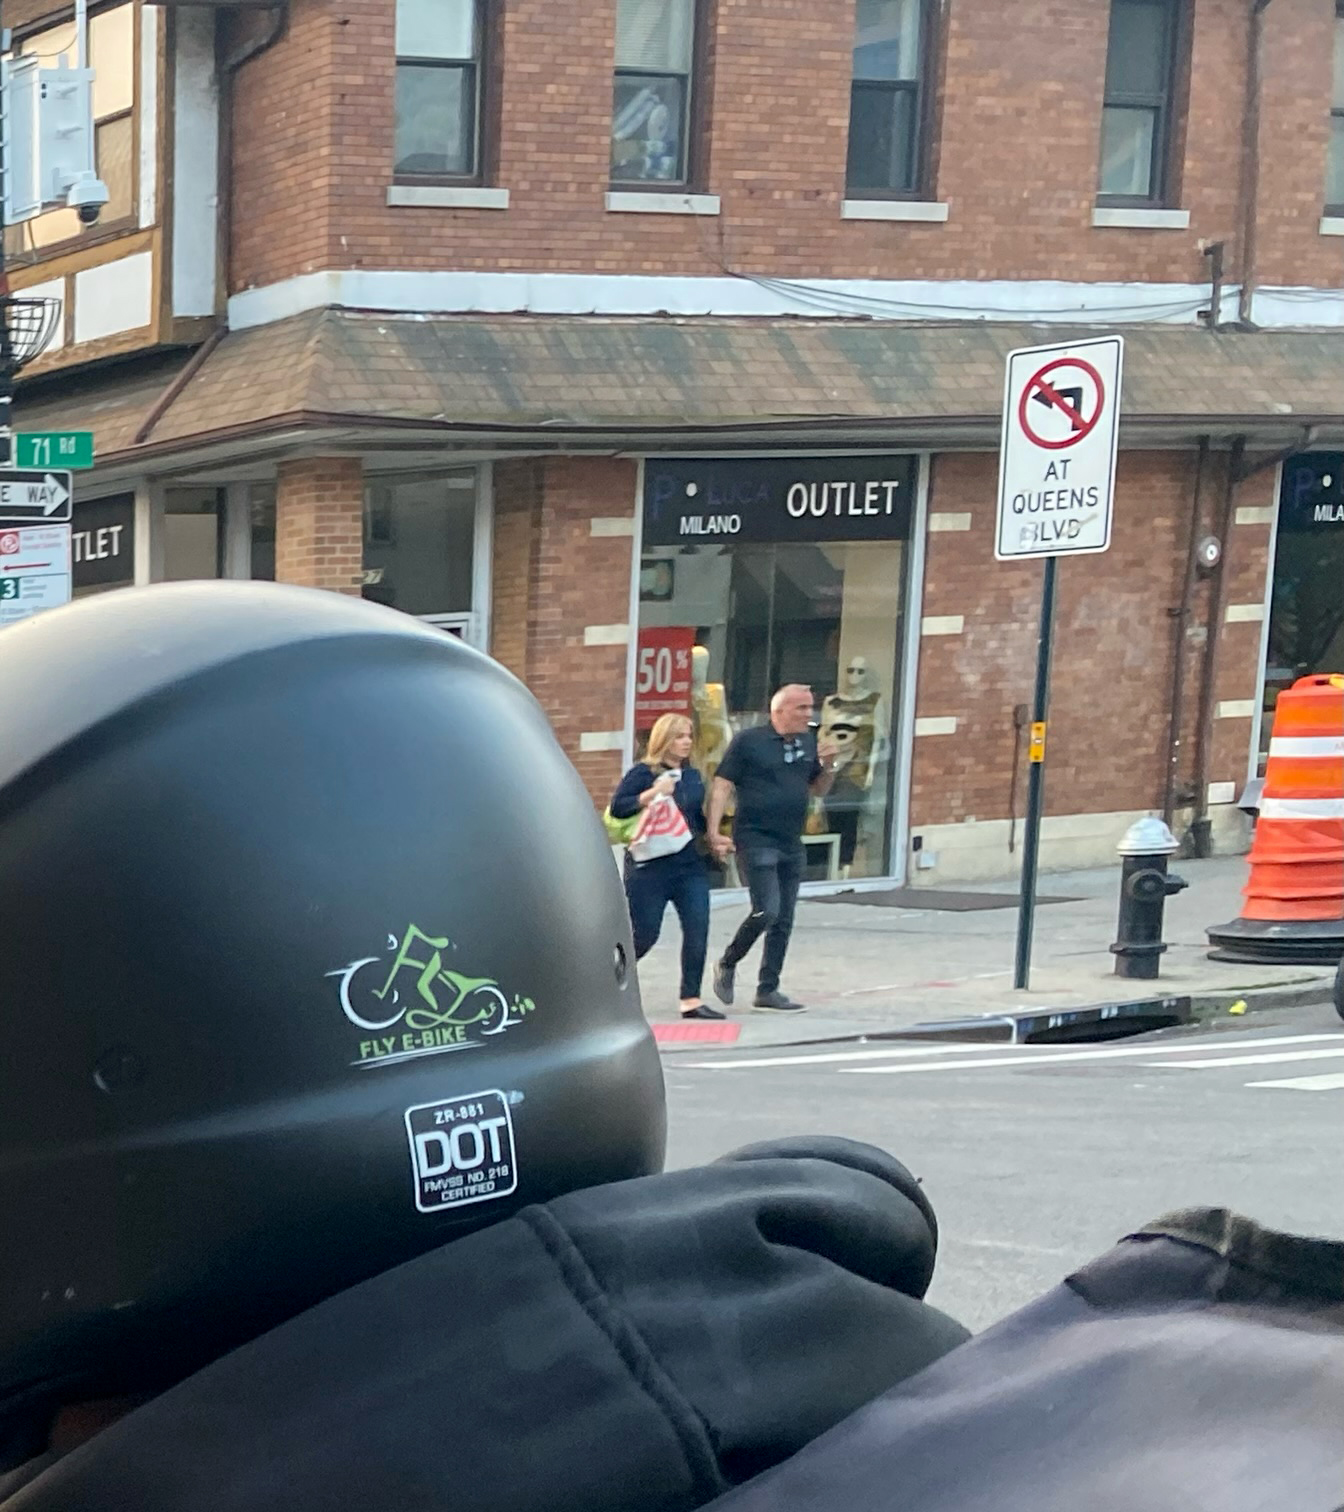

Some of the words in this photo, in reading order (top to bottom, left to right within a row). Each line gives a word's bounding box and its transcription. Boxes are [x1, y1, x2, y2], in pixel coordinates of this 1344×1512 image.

[31, 438, 51, 465] 71
[59, 435, 76, 454] Rd
[1044, 458, 1072, 482] AT
[27, 485, 59, 504] WAY
[786, 480, 900, 518] OUTLET
[1012, 486, 1099, 514] QUEENS
[679, 514, 742, 535] MILANO
[72, 524, 124, 562] TLET
[2, 579, 17, 599] 3
[637, 647, 672, 694] 50
[360, 1036, 395, 1059] FLY
[402, 1025, 467, 1050] E-BIKE
[415, 1116, 507, 1178] DOT
[440, 1180, 496, 1202] CERTIFIED
